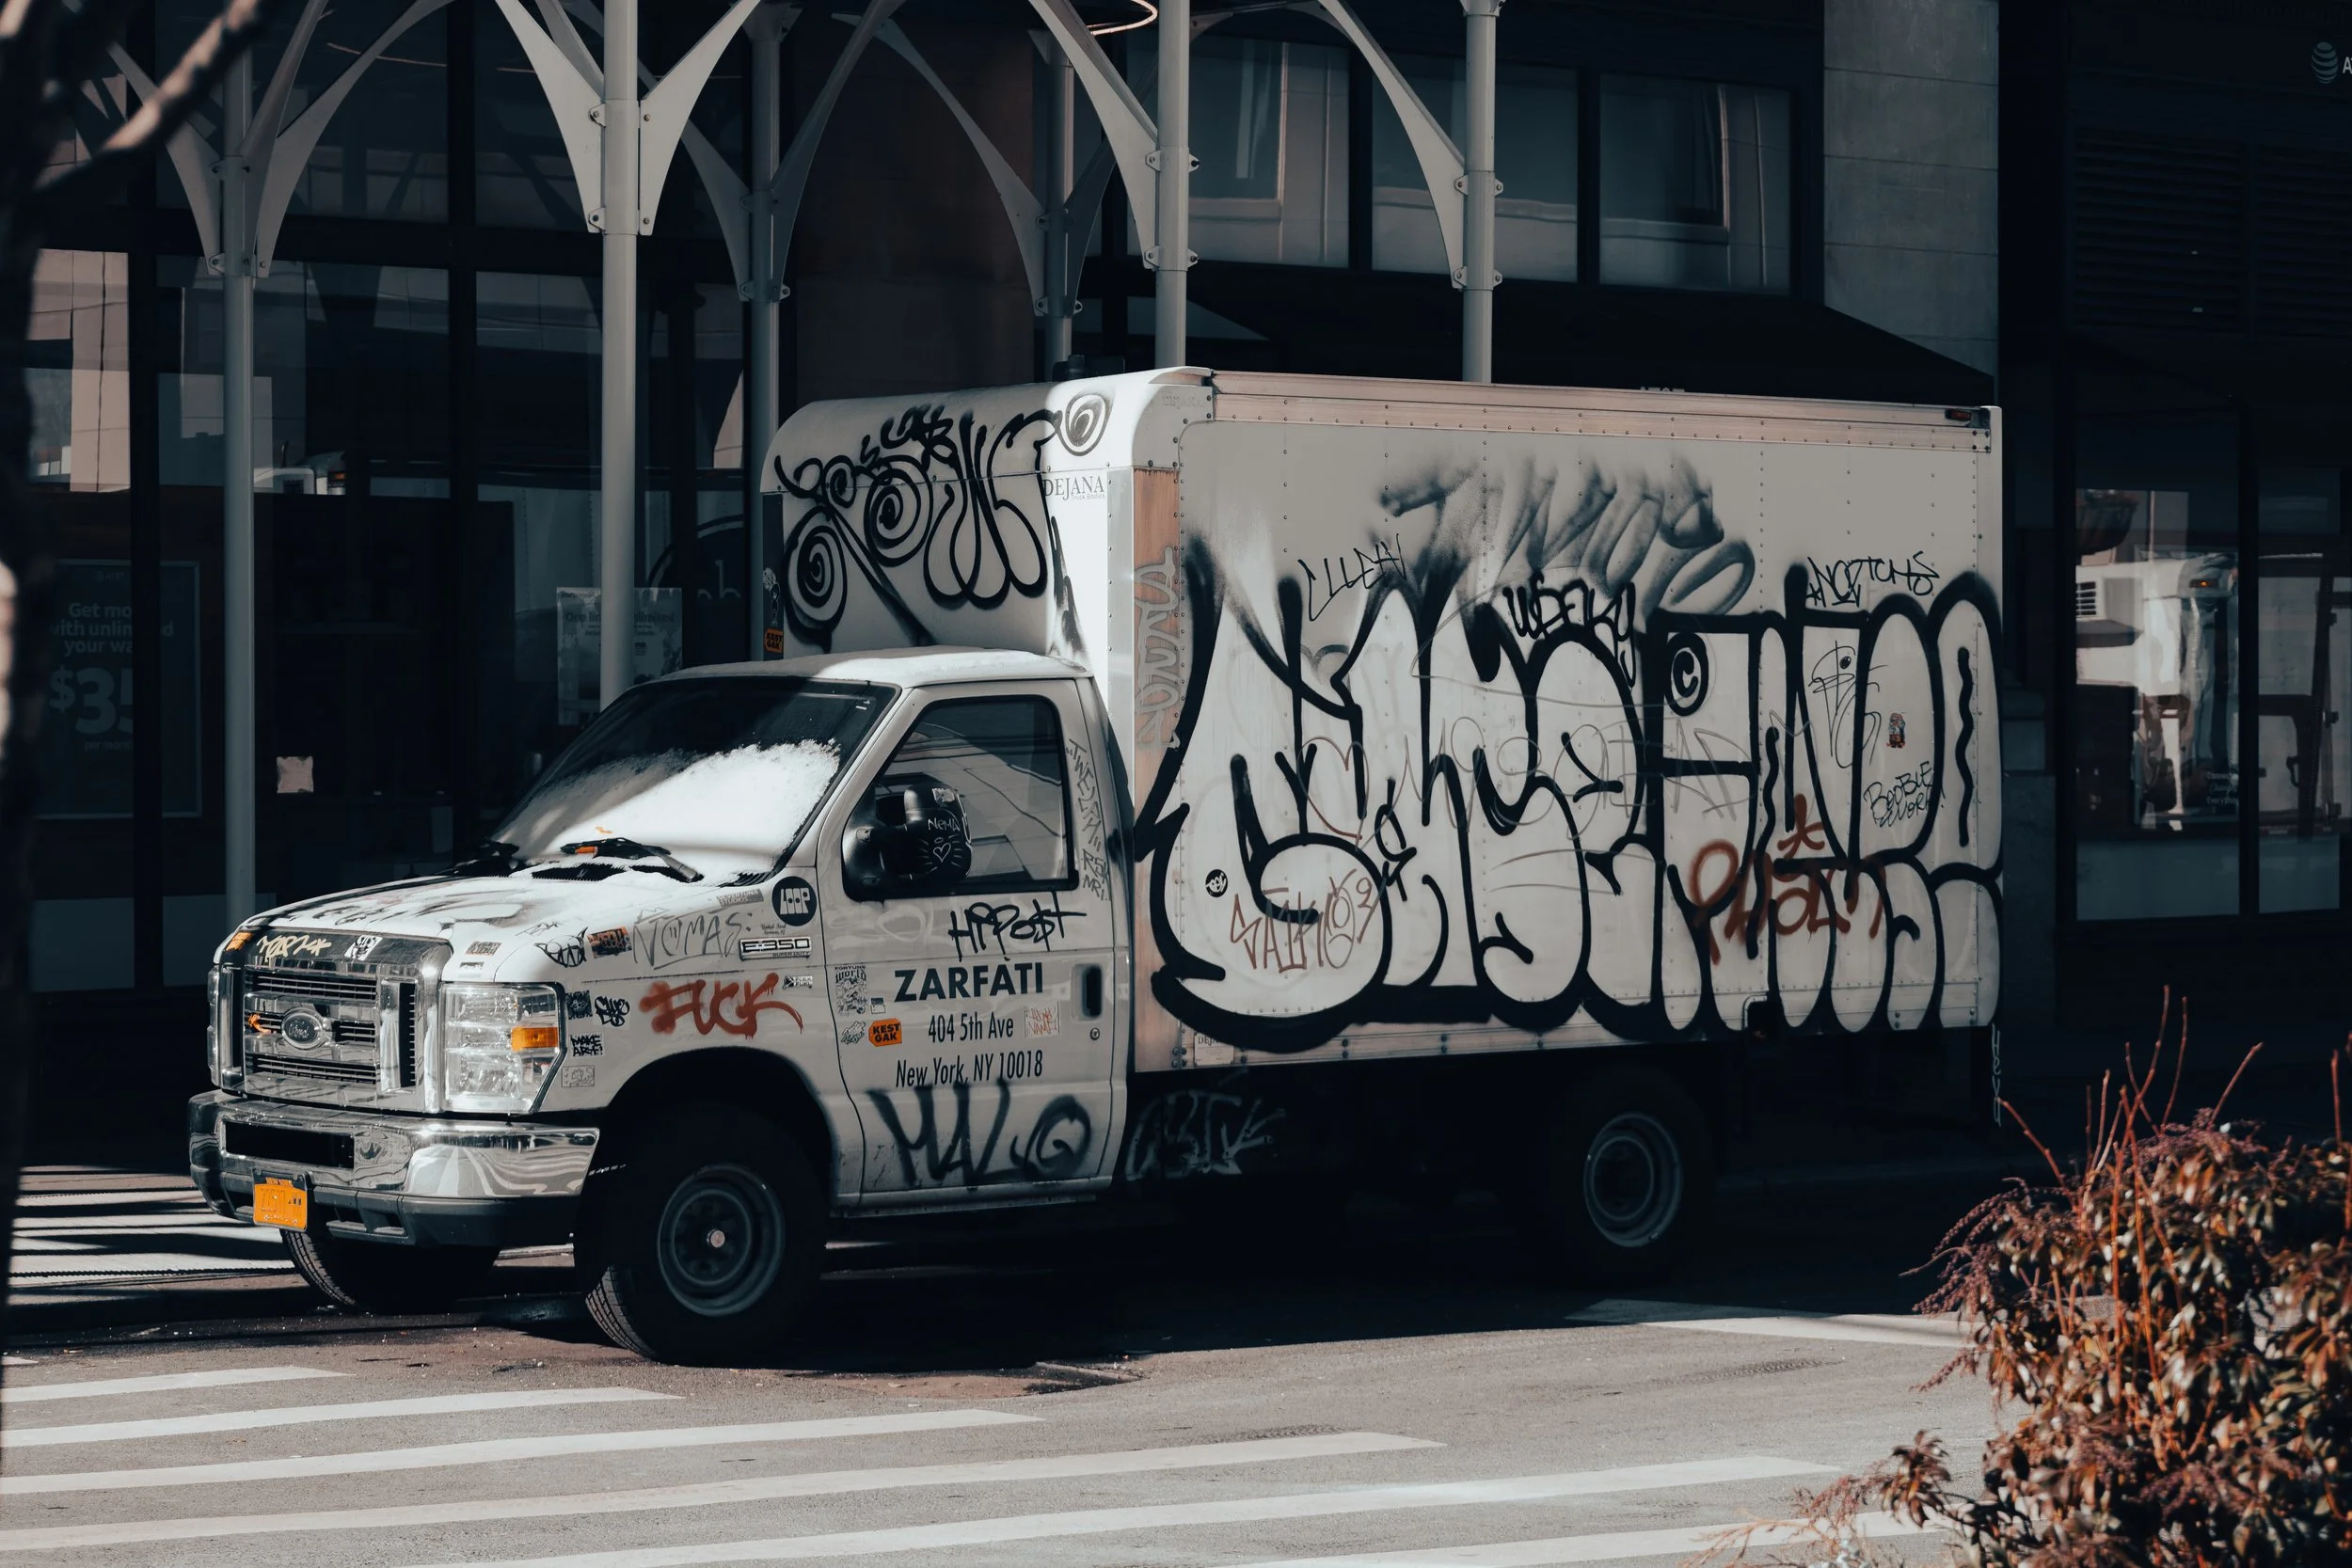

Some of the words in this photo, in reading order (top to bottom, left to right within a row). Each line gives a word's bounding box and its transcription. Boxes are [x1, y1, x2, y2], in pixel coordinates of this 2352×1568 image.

[1042, 475, 1104, 500] DEJANA
[69, 602, 101, 618] Get
[63, 640, 105, 657] your
[780, 887, 811, 915] LOOP
[894, 962, 1043, 1003] ZARFATI
[639, 972, 803, 1039] FUCK
[873, 1023, 900, 1035] KEST
[929, 1014, 955, 1043] 404
[960, 1012, 983, 1041] 5th
[988, 1012, 1014, 1039] Ave
[896, 1059, 928, 1088] New
[933, 1054, 968, 1085] York,
[973, 1053, 994, 1082] NY
[999, 1050, 1043, 1081] 10018
